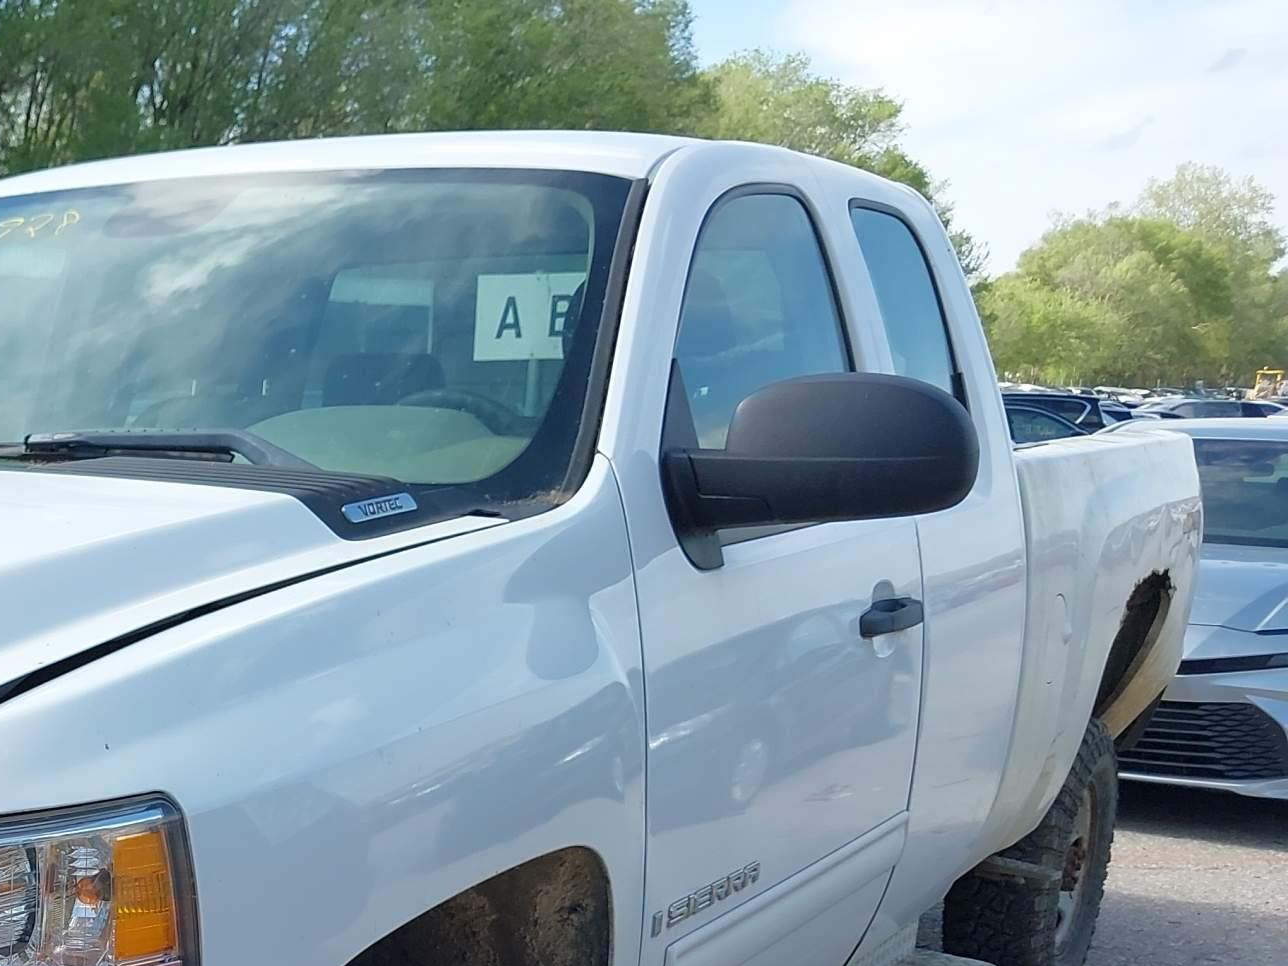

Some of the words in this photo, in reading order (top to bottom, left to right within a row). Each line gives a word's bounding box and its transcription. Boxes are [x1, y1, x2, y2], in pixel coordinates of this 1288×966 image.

[495, 296, 522, 339] A
[357, 496, 404, 517] VORTEC
[666, 860, 761, 928] SIERRA
